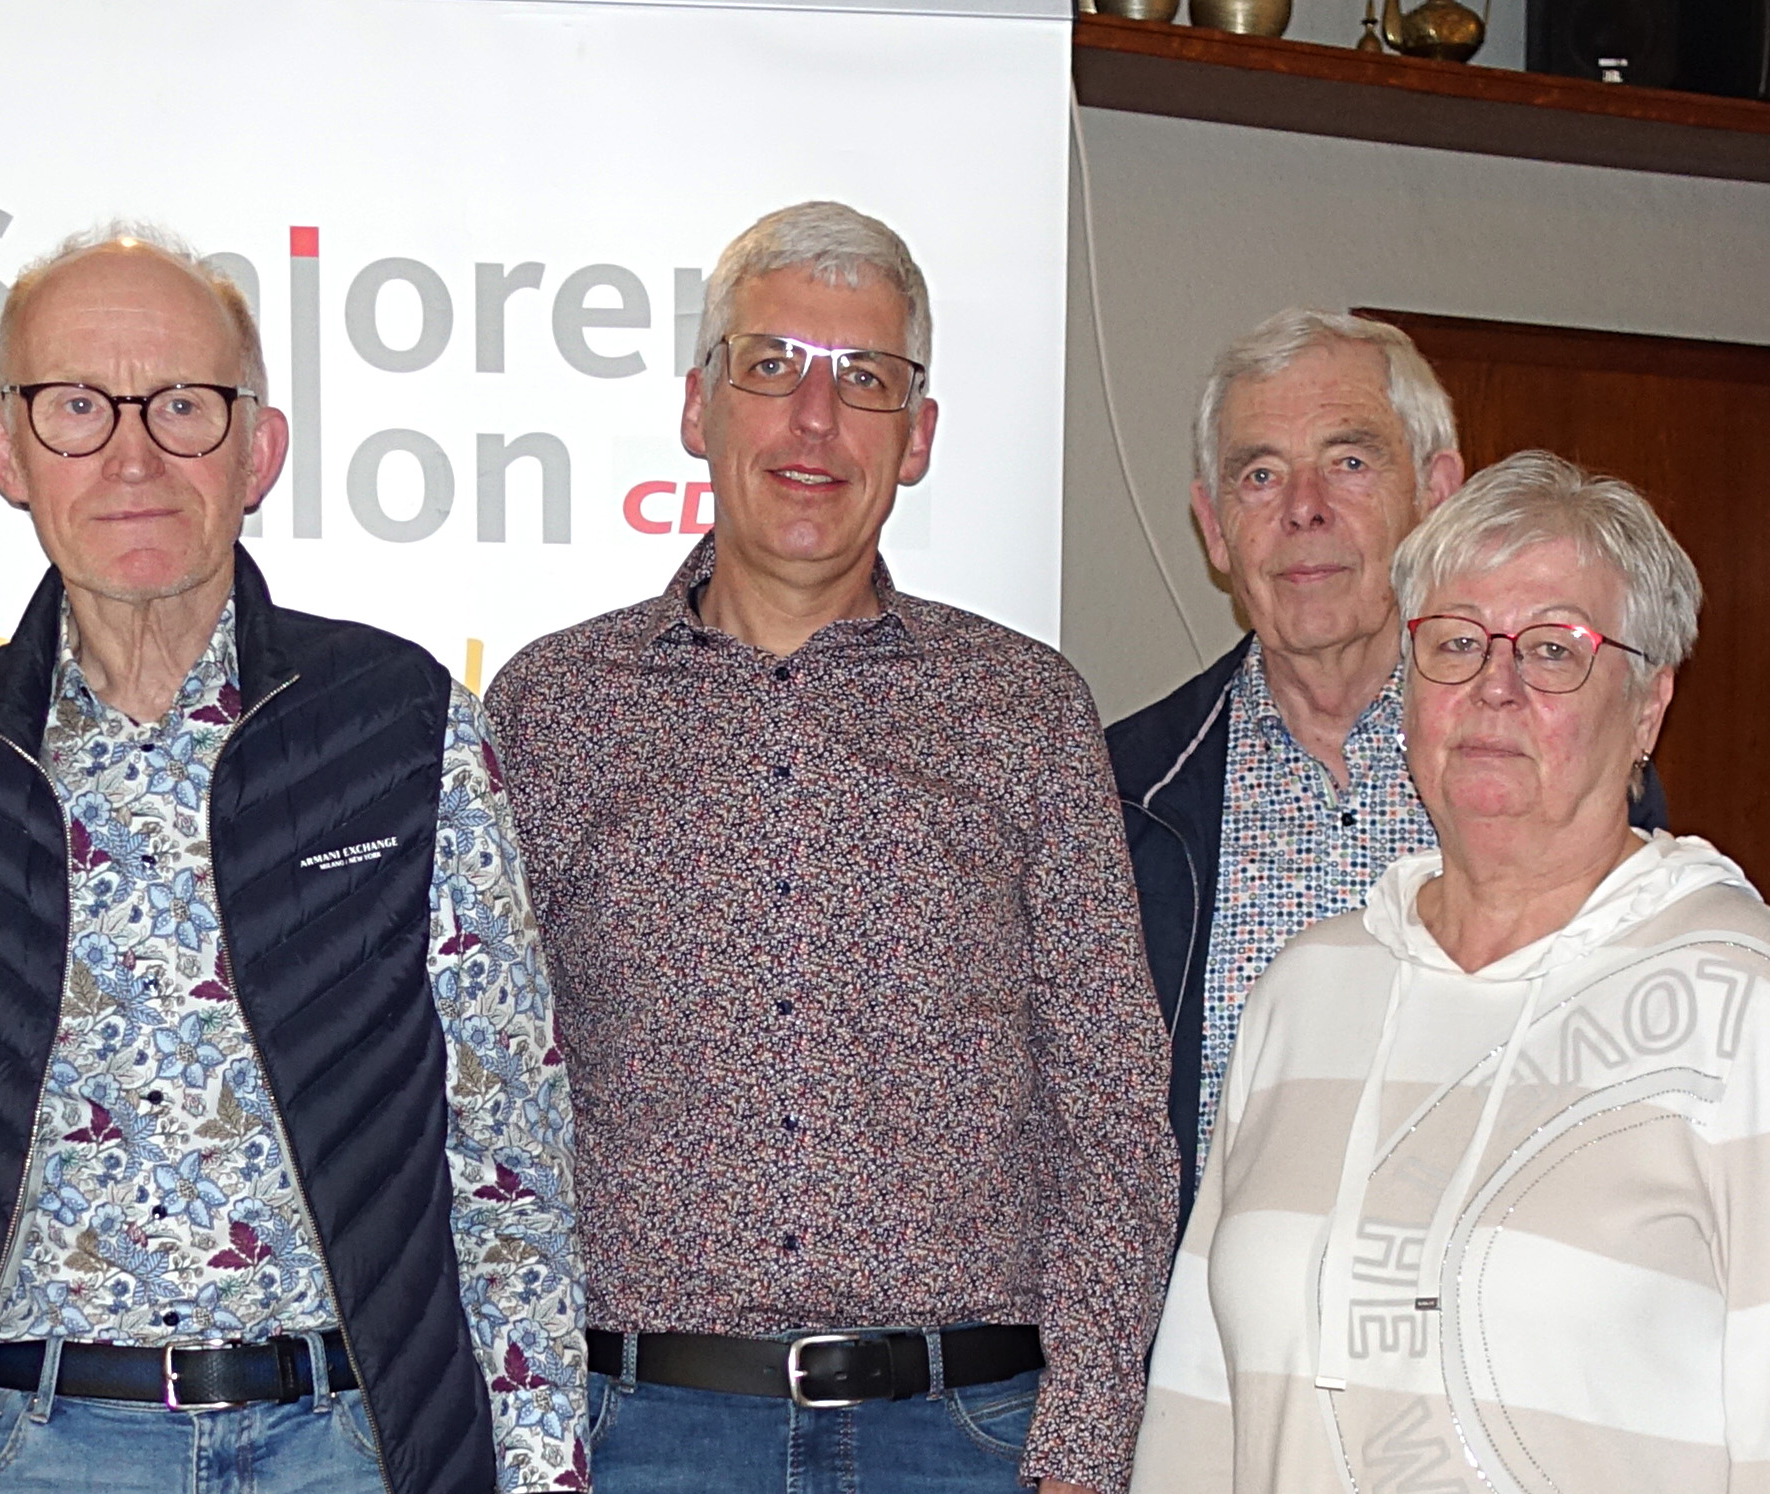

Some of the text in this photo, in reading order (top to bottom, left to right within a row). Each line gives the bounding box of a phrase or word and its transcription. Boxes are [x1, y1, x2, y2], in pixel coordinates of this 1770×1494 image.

[622, 480, 715, 535] CD
[300, 836, 398, 868] ARMANI EXCHANGE
